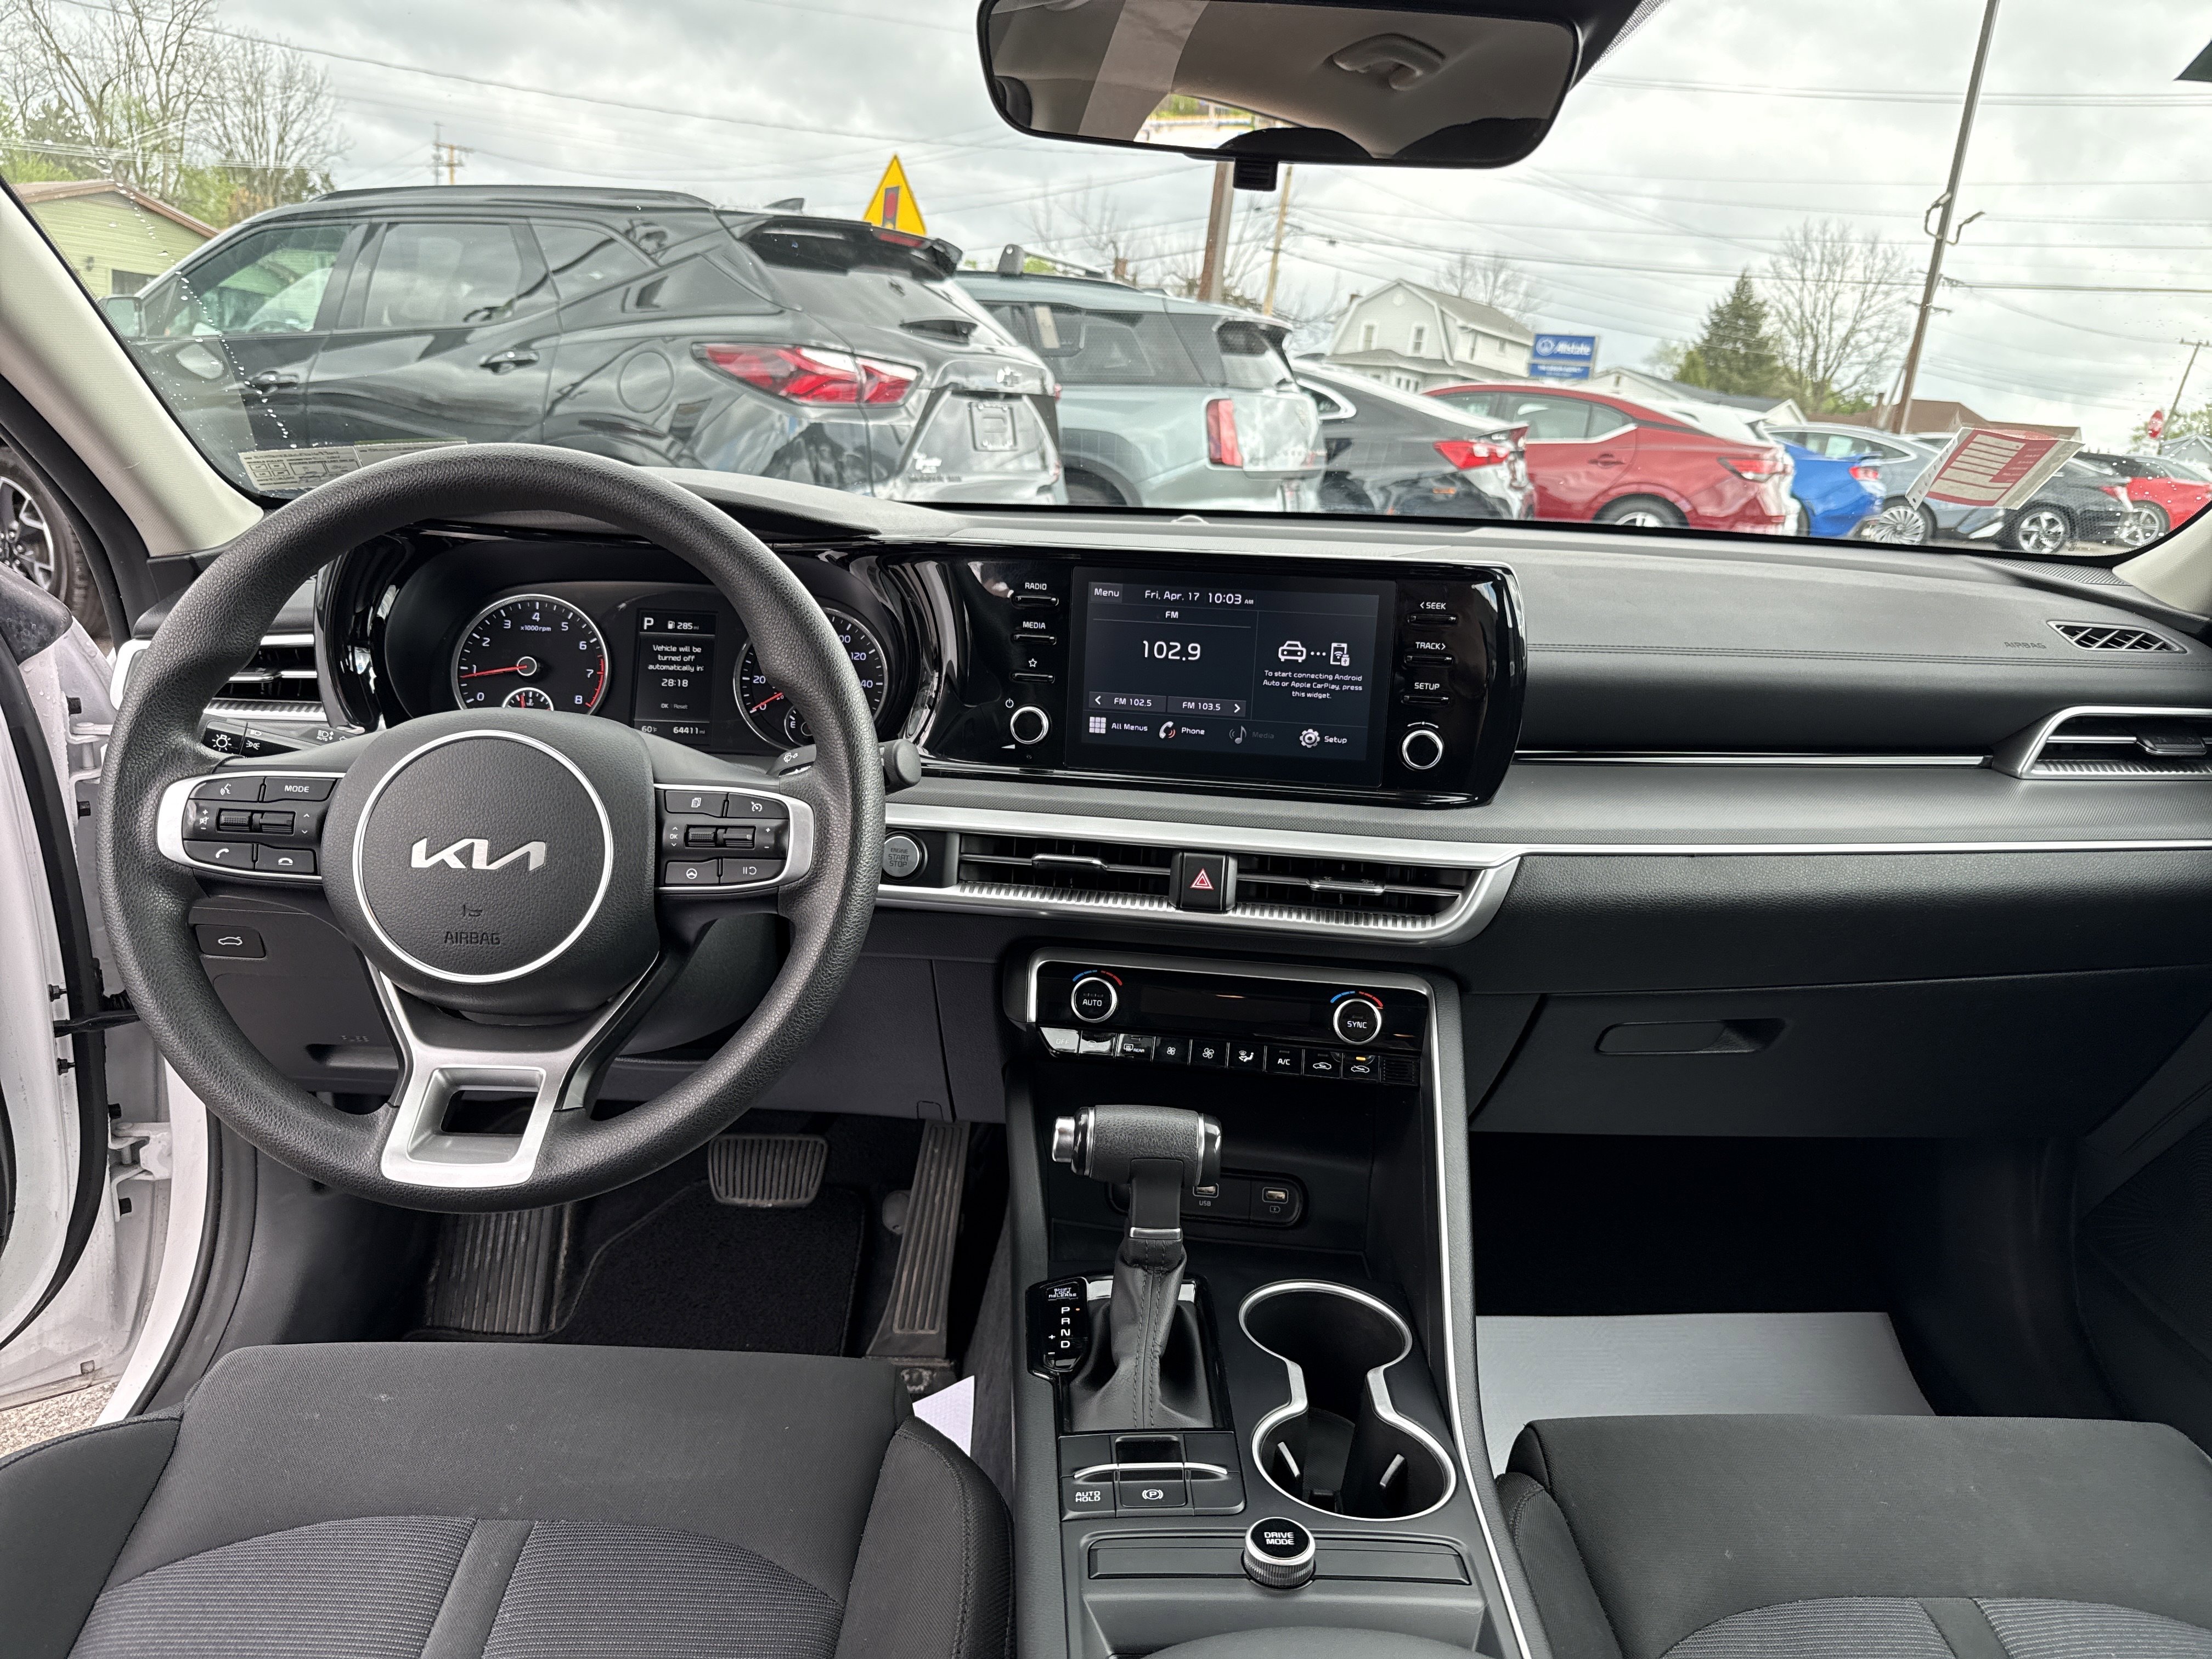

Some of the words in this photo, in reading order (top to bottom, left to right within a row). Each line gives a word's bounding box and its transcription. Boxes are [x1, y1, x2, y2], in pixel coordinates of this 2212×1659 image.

[1025, 582, 1047, 590] RADIO
[1094, 588, 1119, 597] Menu
[1163, 591, 1184, 601] Apr.
[1188, 591, 1200, 601] 17
[1208, 592, 1242, 605] 10:03
[532, 612, 540, 622] 4
[1165, 611, 1179, 619] FM
[503, 619, 511, 629] 3
[561, 622, 569, 631] 5
[644, 617, 654, 630] P
[1023, 621, 1046, 629] MEDIA
[482, 637, 490, 647] 2
[838, 635, 851, 643] 00
[579, 641, 587, 650] 6
[1415, 642, 1441, 650] TRACK
[2004, 641, 2047, 650] AIRBAG
[1143, 640, 1201, 661] 102.9
[850, 652, 866, 661] 120
[472, 664, 477, 676] 1
[648, 664, 695, 672] automatically
[586, 669, 594, 678] 7
[1294, 672, 1333, 680] connecting
[661, 678, 689, 687] 28:18
[753, 675, 766, 684] 20
[861, 679, 873, 688] 40
[477, 692, 484, 701] 0
[574, 695, 583, 704] 8
[1129, 698, 1152, 708] 102.5
[1182, 702, 1195, 710] FM
[1198, 702, 1221, 712] 103.5
[1111, 722, 1122, 730] All
[1124, 723, 1148, 732] Menus
[1181, 727, 1205, 736] Phone
[1252, 731, 1274, 740] Media
[1324, 736, 1347, 745] Setup
[411, 838, 546, 871] KIA
[444, 931, 501, 946] AIRBAG
[1082, 998, 1102, 1007] AUTO
[1060, 1340, 1070, 1348] D
